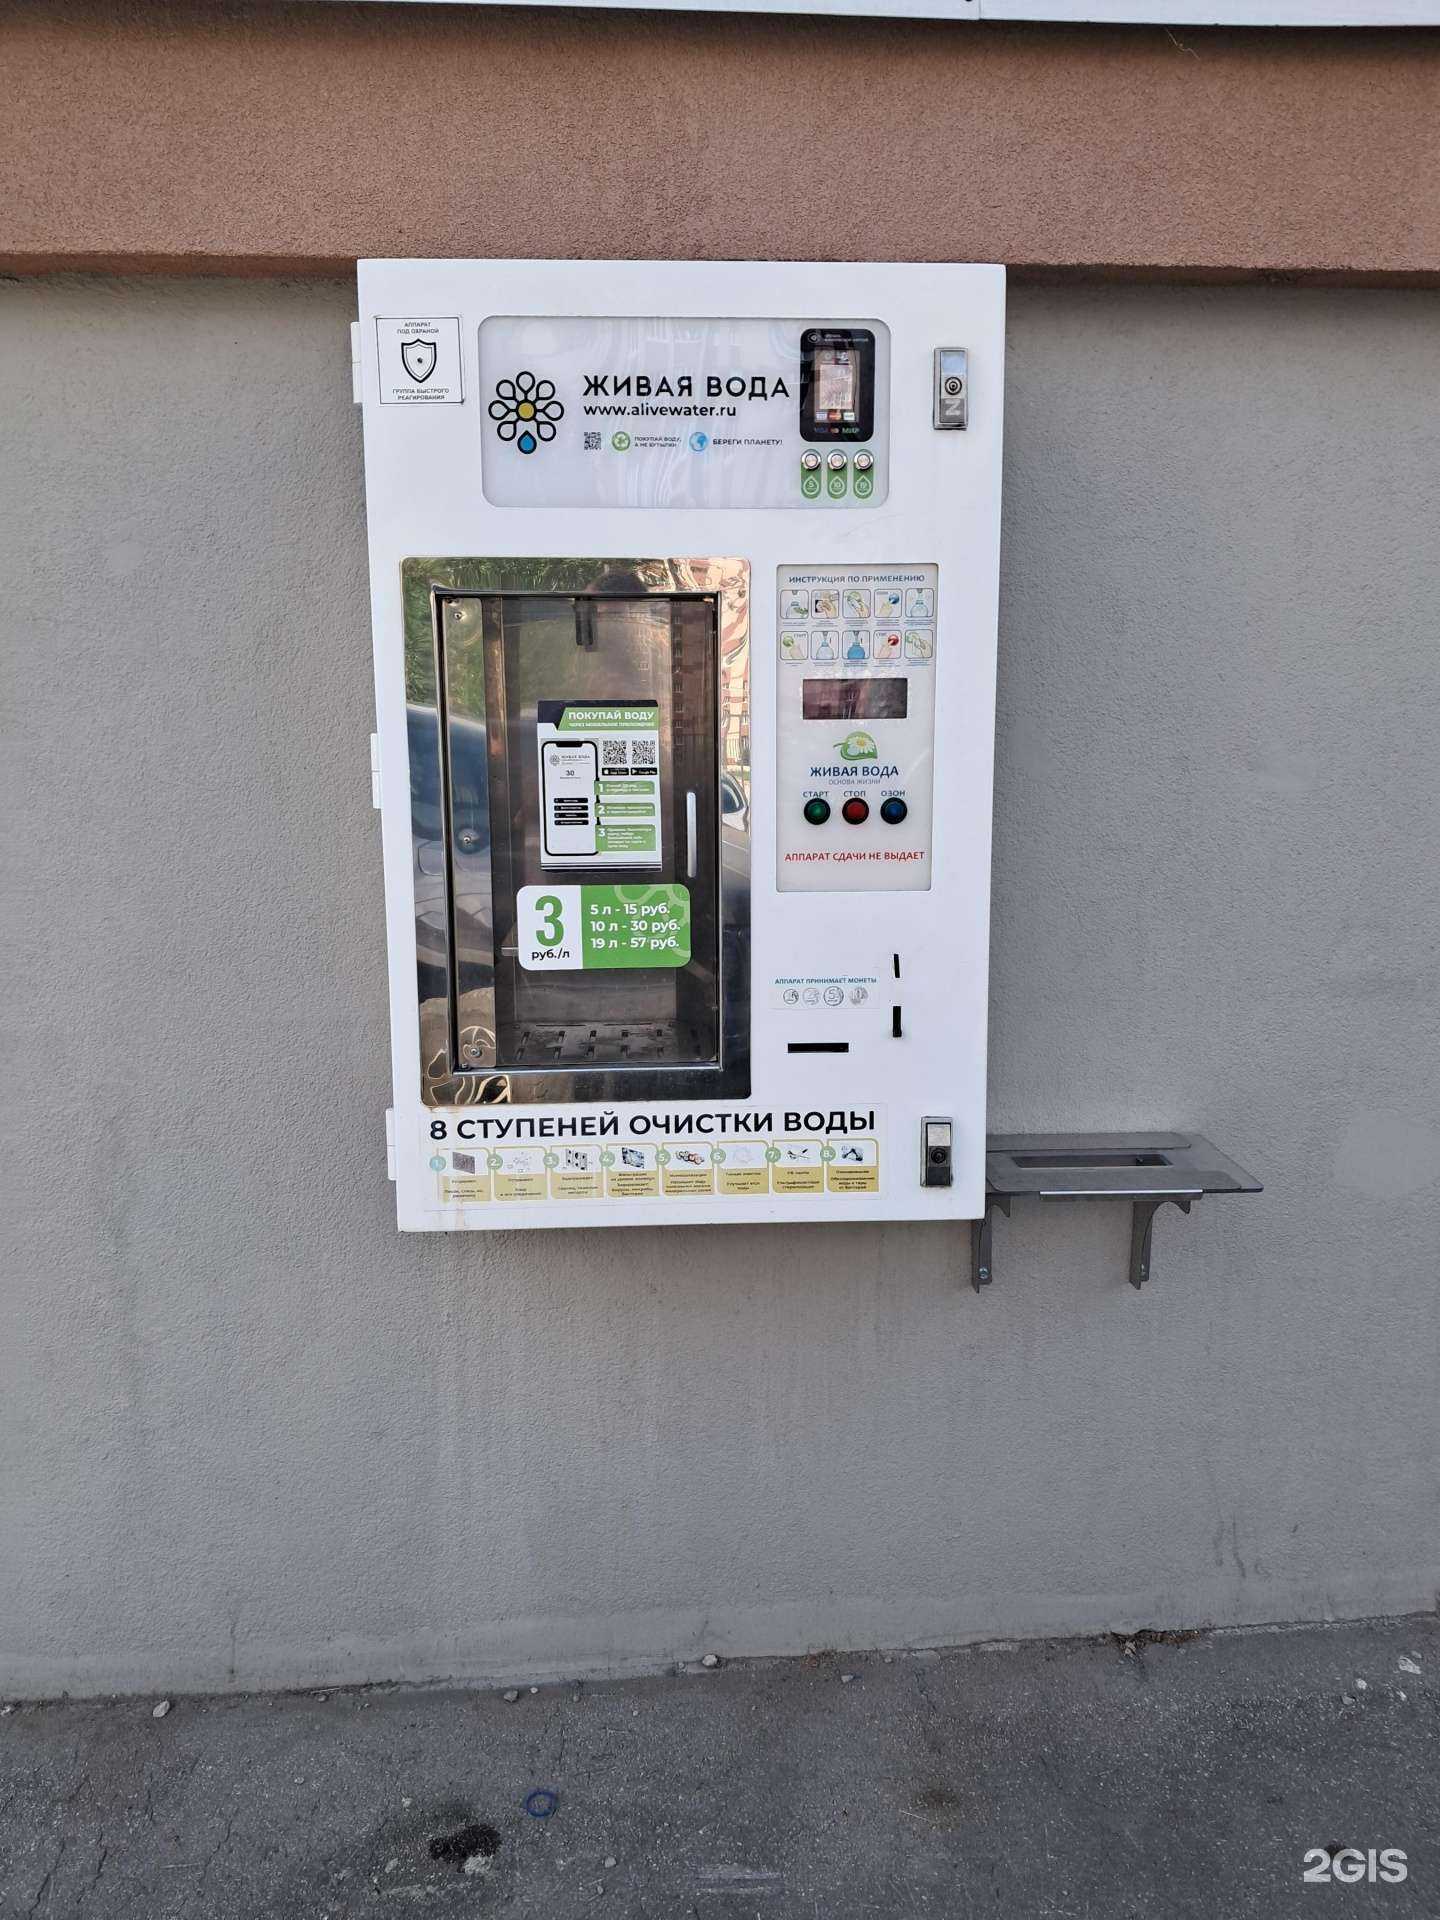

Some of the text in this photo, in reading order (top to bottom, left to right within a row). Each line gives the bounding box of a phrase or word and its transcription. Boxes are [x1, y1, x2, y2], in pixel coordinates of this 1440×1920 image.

[582, 375, 790, 401] ЖИВАЯ ВОДА
[583, 403, 737, 417] www.alivewater.ru
[788, 574, 925, 585] ИНСТРУКЦИЯ ПО ПРИМЕНЕНИЮ
[568, 710, 655, 721] ПОКУПАЙ ВОДУ
[810, 765, 899, 779] ЖИВАЯ ВОДА
[598, 783, 604, 793] 1
[597, 805, 605, 815] 2
[598, 828, 606, 837] 3
[784, 851, 925, 863] АППАРАТ СДАЧИ НЕ ВЫДАЕТ
[590, 904, 598, 915] 5
[602, 905, 612, 915] л
[623, 903, 637, 915] 15
[641, 902, 671, 917] руб.
[534, 894, 565, 947] 3
[590, 921, 605, 932] 10
[608, 922, 618, 932] л
[630, 920, 648, 931] 30
[651, 918, 681, 934] руб.
[590, 938, 605, 949] 19
[608, 938, 618, 949] л
[630, 937, 646, 948] 57
[650, 936, 680, 950] руб.
[531, 947, 571, 961] руб./л
[847, 976, 877, 984] МОНЕТЫ
[430, 1110, 876, 1140] 8 СТУПЕНЕЙ ОЧИСТКИ ВОДЫ
